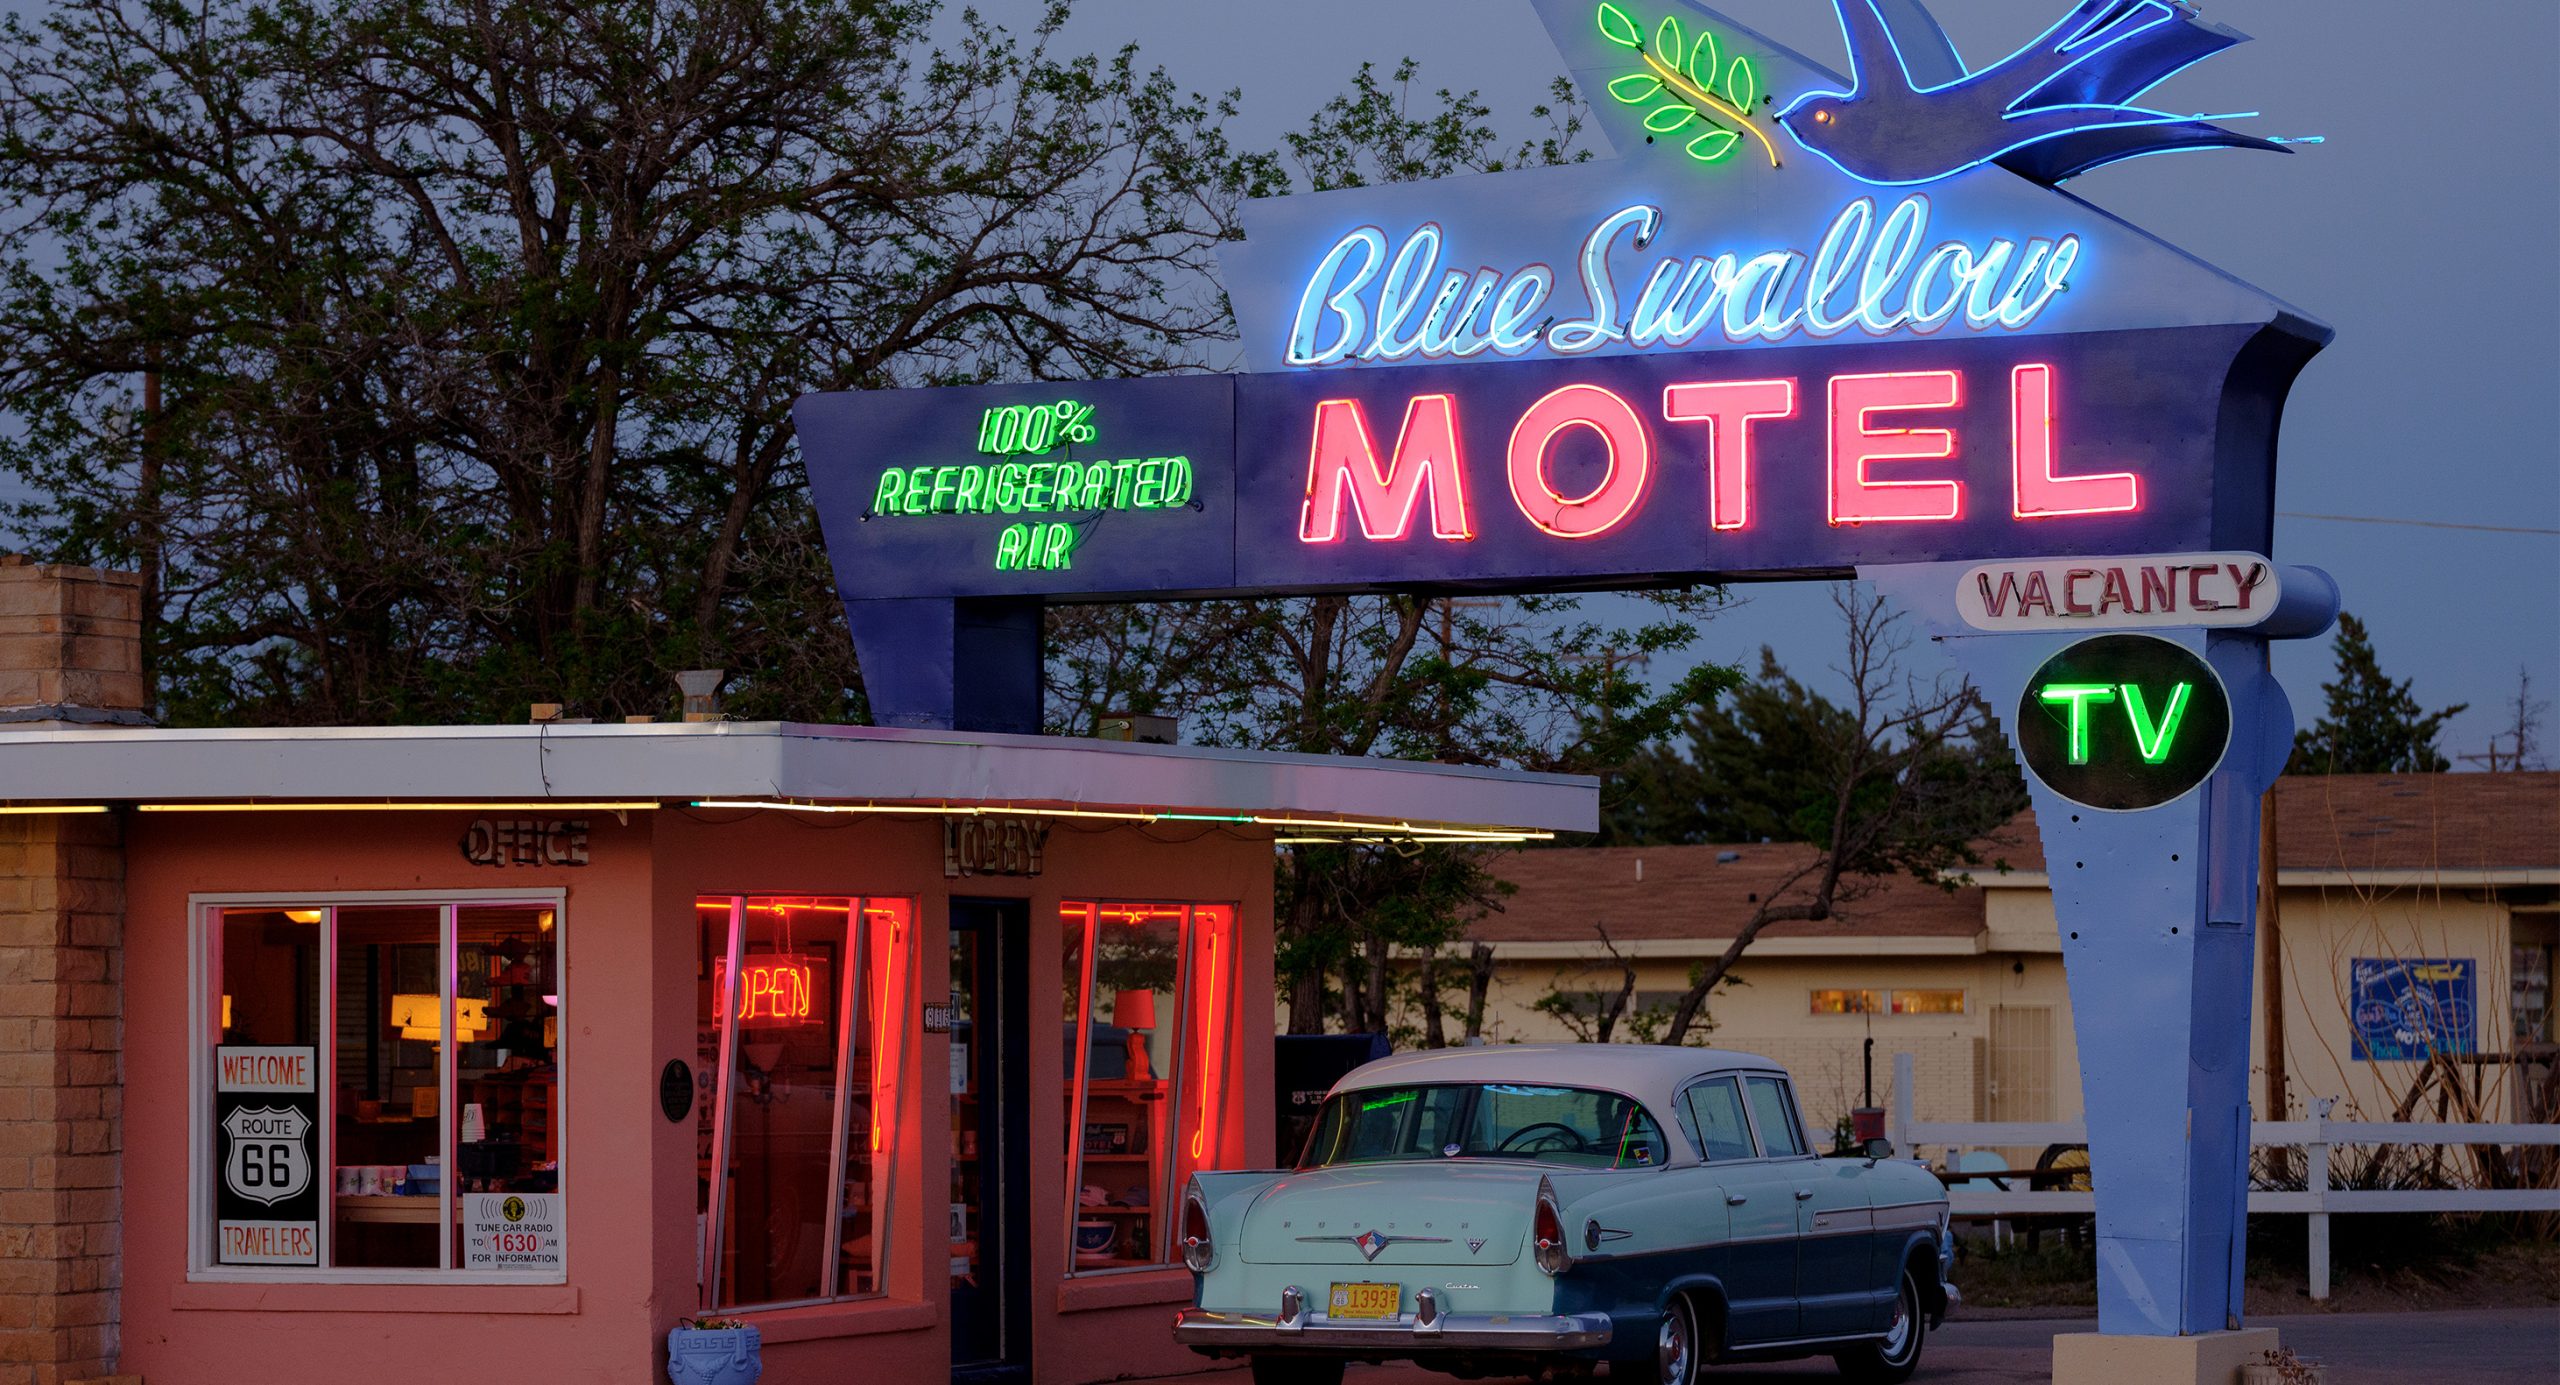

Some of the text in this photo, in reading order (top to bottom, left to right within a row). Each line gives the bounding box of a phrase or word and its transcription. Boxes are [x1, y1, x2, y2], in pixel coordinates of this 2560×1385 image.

[1284, 193, 2080, 368] Blue Swallow
[978, 399, 1096, 455] 100%
[1298, 363, 2140, 543] MOTEL
[873, 455, 1194, 516] REFRIGERATED
[995, 521, 1074, 570] AIR
[1977, 562, 2262, 618] VACANCY
[2041, 681, 2193, 766] TV
[464, 819, 590, 867] OFFICE
[223, 1054, 307, 1086] WELCOME
[242, 1119, 292, 1135] ROUTE
[242, 1144, 290, 1187] 66
[223, 1226, 313, 1257] TRAVELERS
[472, 1233, 557, 1252] TO 1630 AM
[475, 1223, 552, 1232] TUNE CAR RADIO
[472, 1254, 558, 1263] FOR INFORMATION
[1350, 1289, 1389, 1308] 1393
